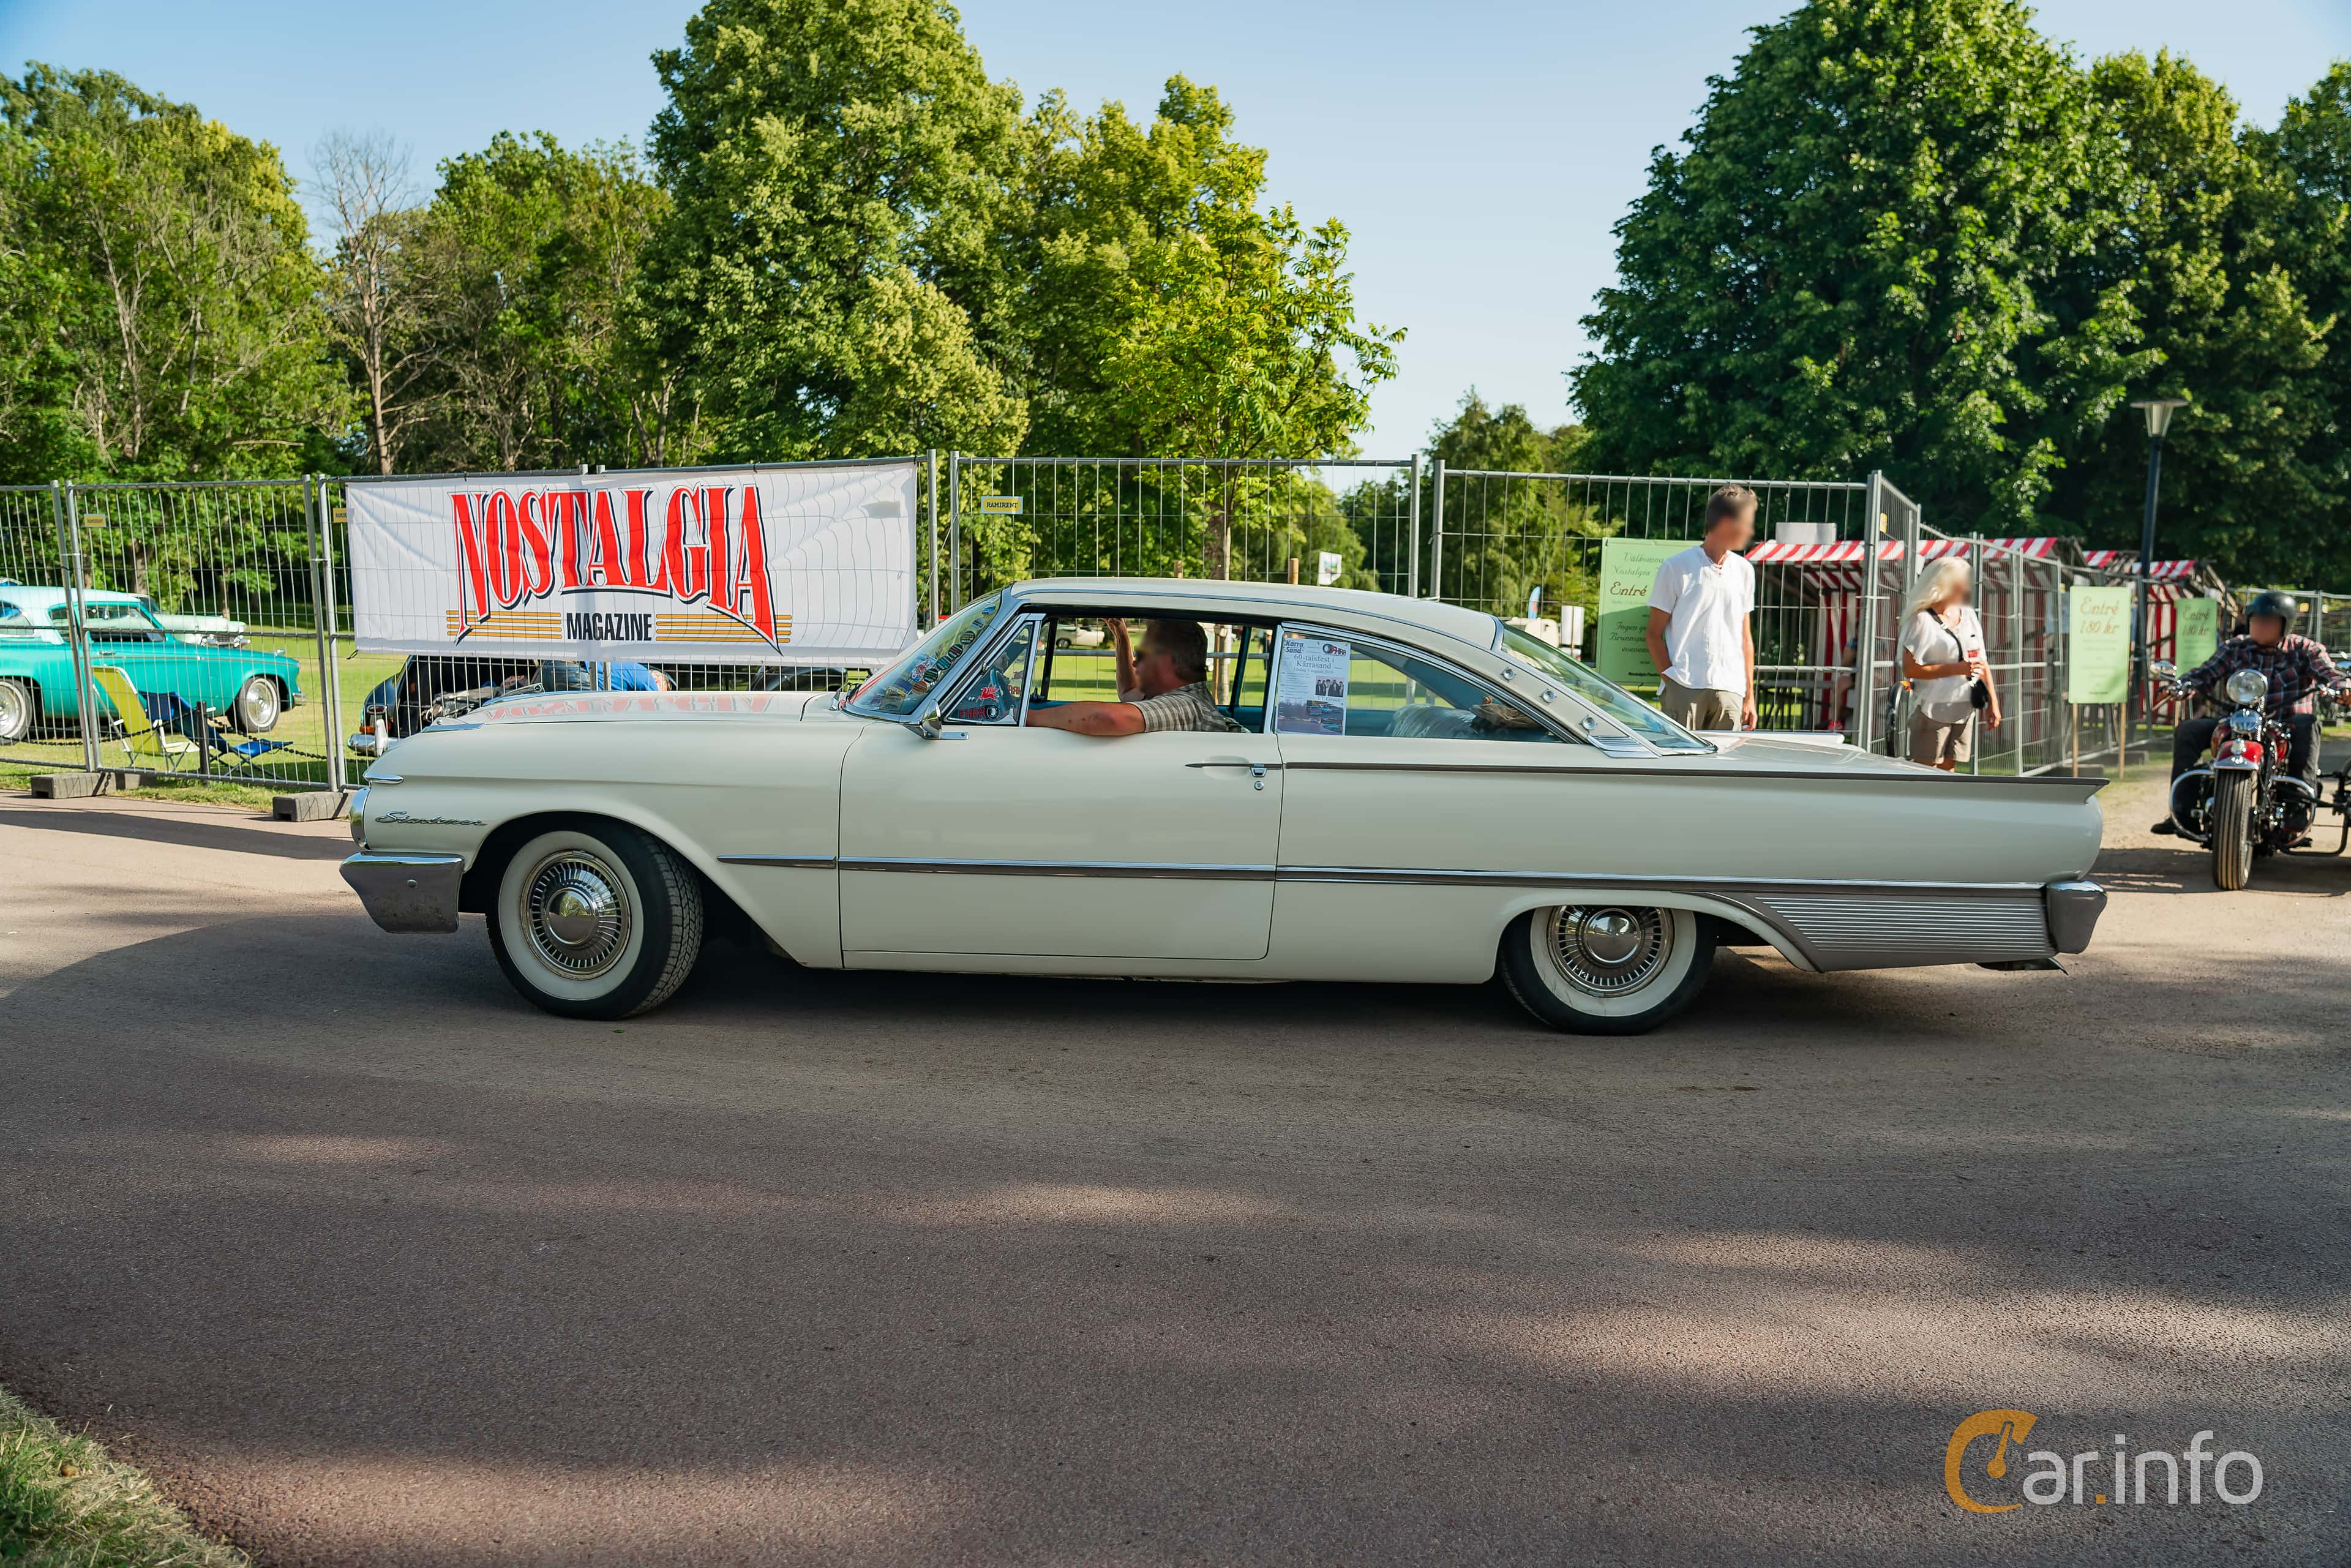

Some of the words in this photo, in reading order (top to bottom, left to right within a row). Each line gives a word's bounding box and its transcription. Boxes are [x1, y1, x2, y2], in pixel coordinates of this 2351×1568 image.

[449, 483, 782, 657] NOSTALGIA
[1613, 565, 1651, 578] Nostalgia
[1610, 582, 1648, 596] Entré
[2080, 596, 2120, 615] Entré
[2182, 606, 2210, 621] Entré
[566, 612, 653, 642] MAGAZINE
[2103, 616, 2120, 634] kr
[1610, 632, 1646, 643] Brunnspa
